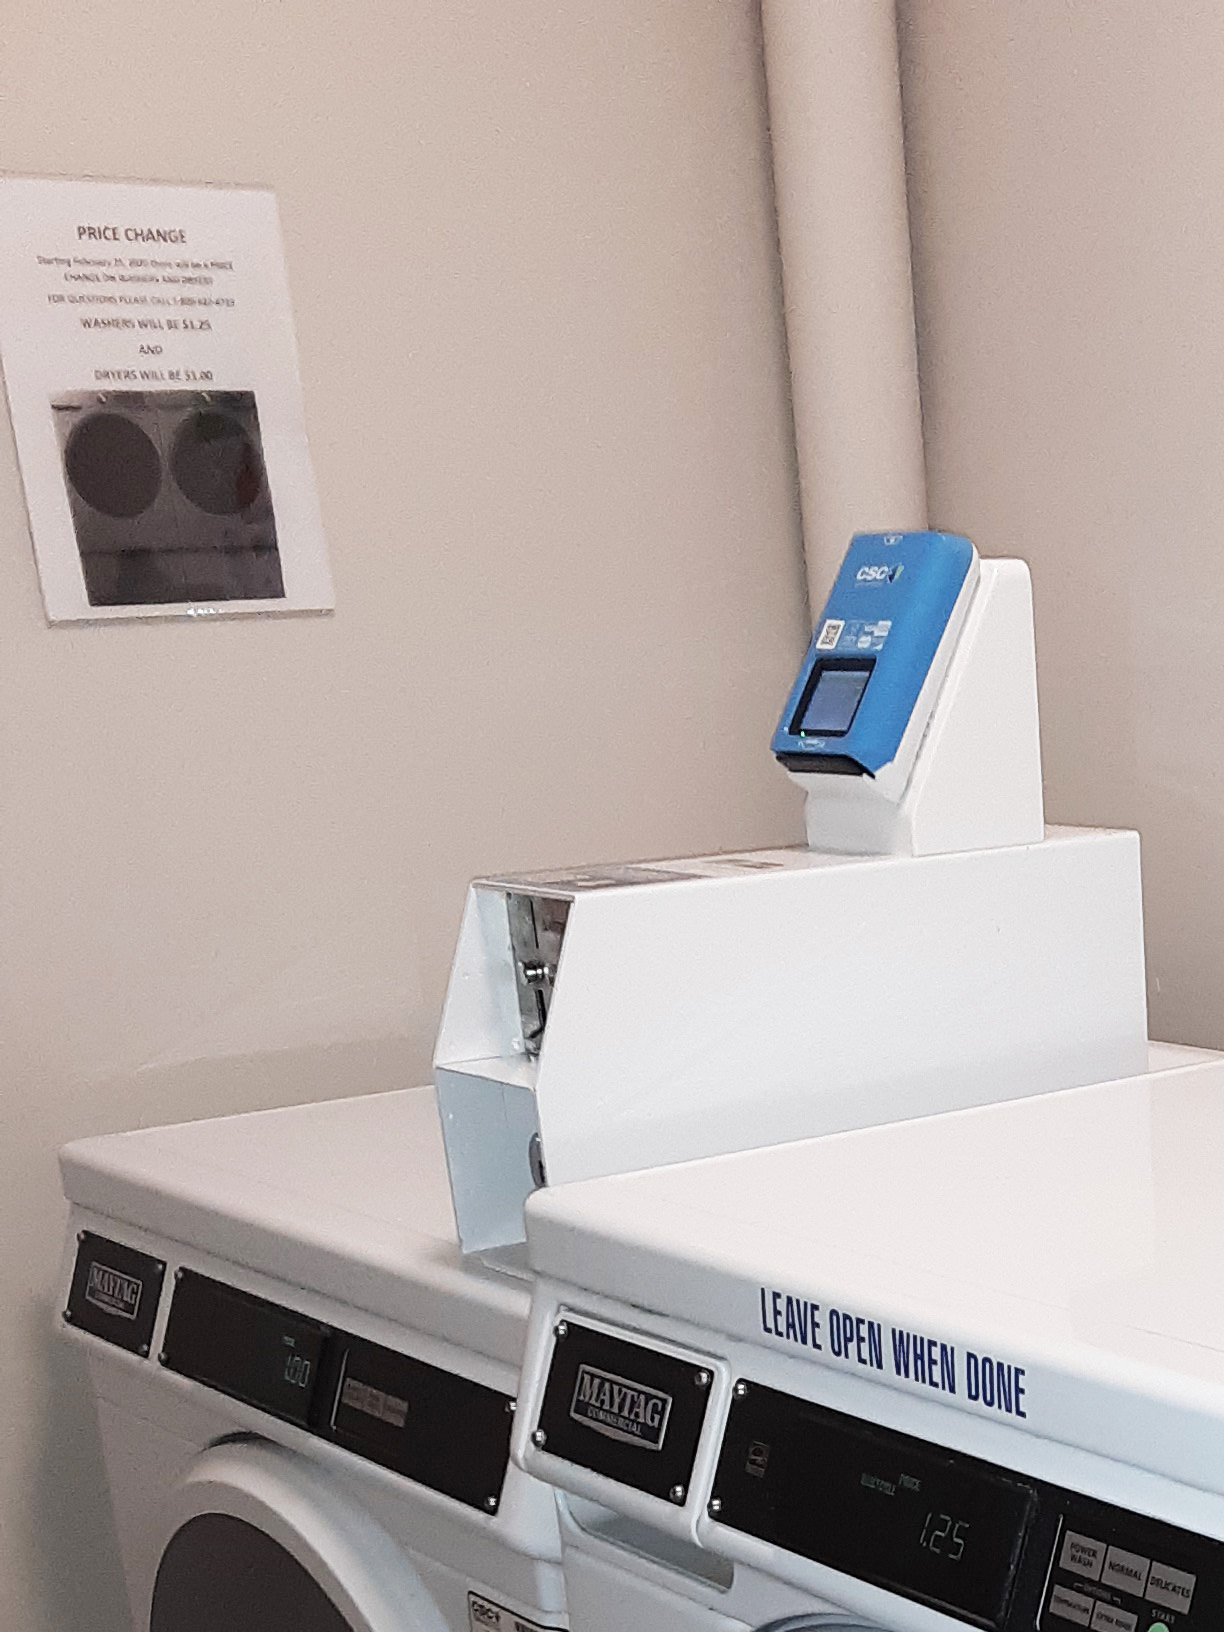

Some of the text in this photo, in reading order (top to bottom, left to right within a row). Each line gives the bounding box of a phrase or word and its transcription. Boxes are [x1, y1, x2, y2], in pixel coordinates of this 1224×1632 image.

[77, 226, 187, 243] PRICE CHANGE
[80, 317, 136, 331] WASHERS
[137, 318, 164, 331] WILL
[167, 319, 180, 331] BE
[139, 344, 163, 356] AND
[94, 369, 213, 383] DRYERS WILL BE $1.00
[855, 564, 889, 582] CSC
[89, 1266, 137, 1304] MAYTAG
[760, 1287, 1027, 1419] LEAVE OPEN WHEN DONE
[579, 1373, 663, 1429] MAYTAG
[919, 1512, 970, 1561] 1.25
[1070, 1542, 1098, 1559] POWER
[1070, 1554, 1094, 1569] WASH
[1108, 1560, 1143, 1582] NORMAL
[1149, 1575, 1191, 1599] DELICATES
[1151, 1608, 1176, 1624] START
